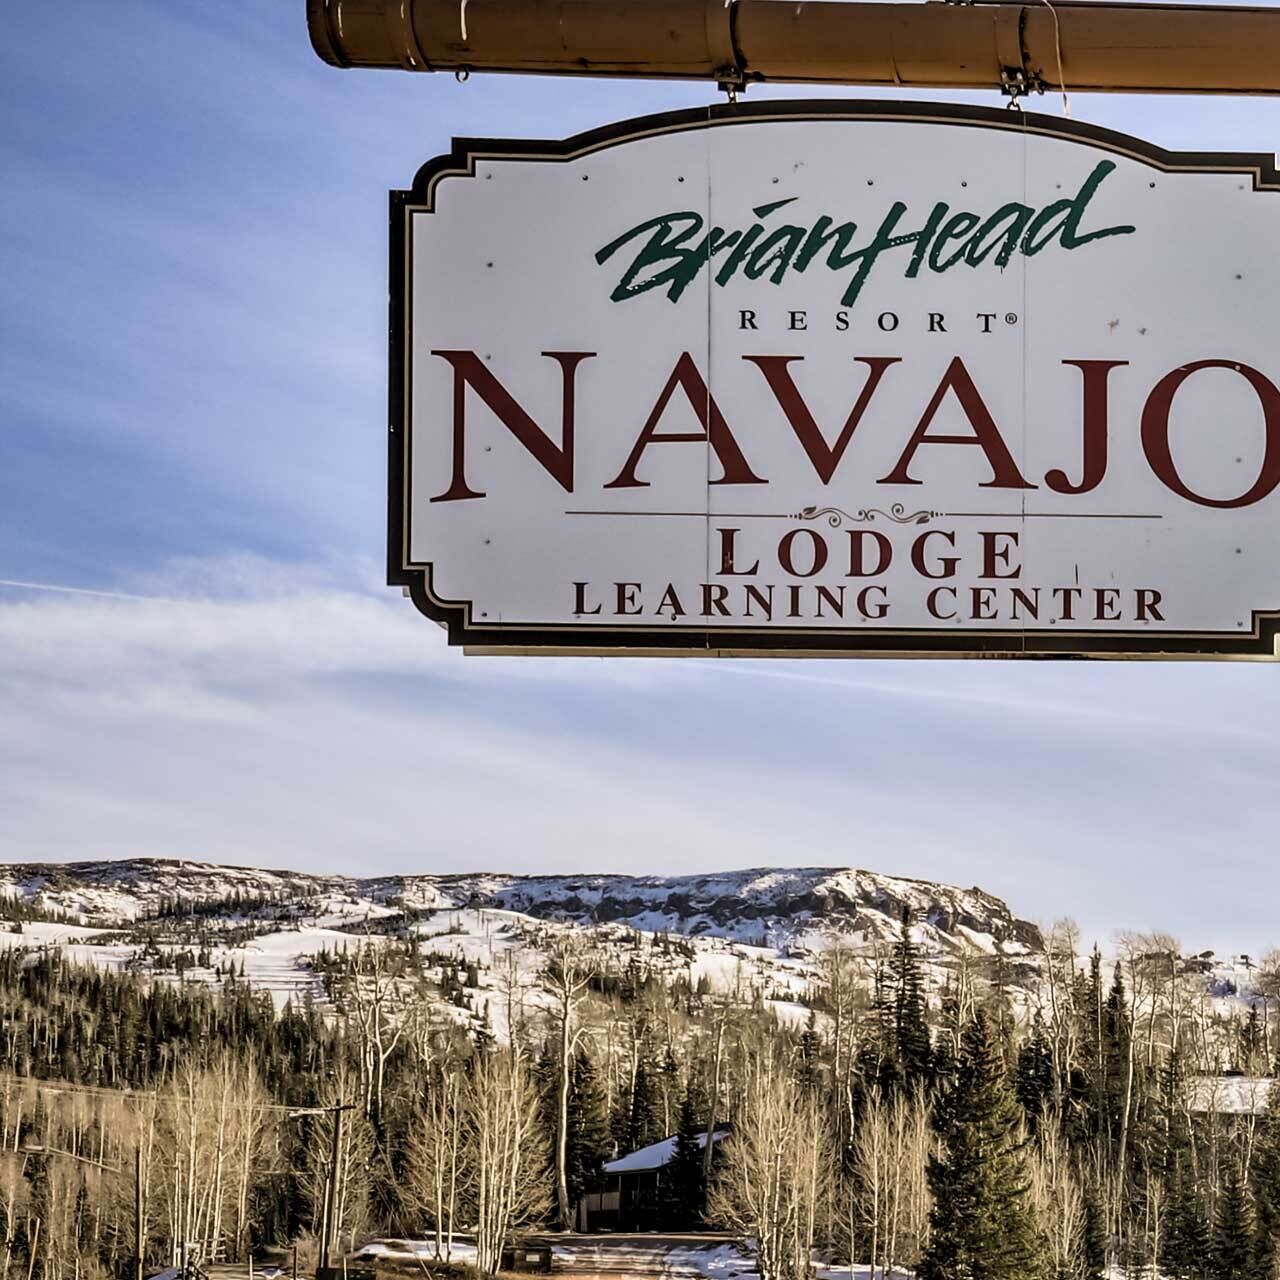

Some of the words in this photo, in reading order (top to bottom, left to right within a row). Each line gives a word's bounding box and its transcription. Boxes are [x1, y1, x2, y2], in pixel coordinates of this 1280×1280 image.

[715, 528, 1022, 579] LODGE
[572, 581, 890, 620] LEARNING
[926, 586, 1166, 622] CENTER
